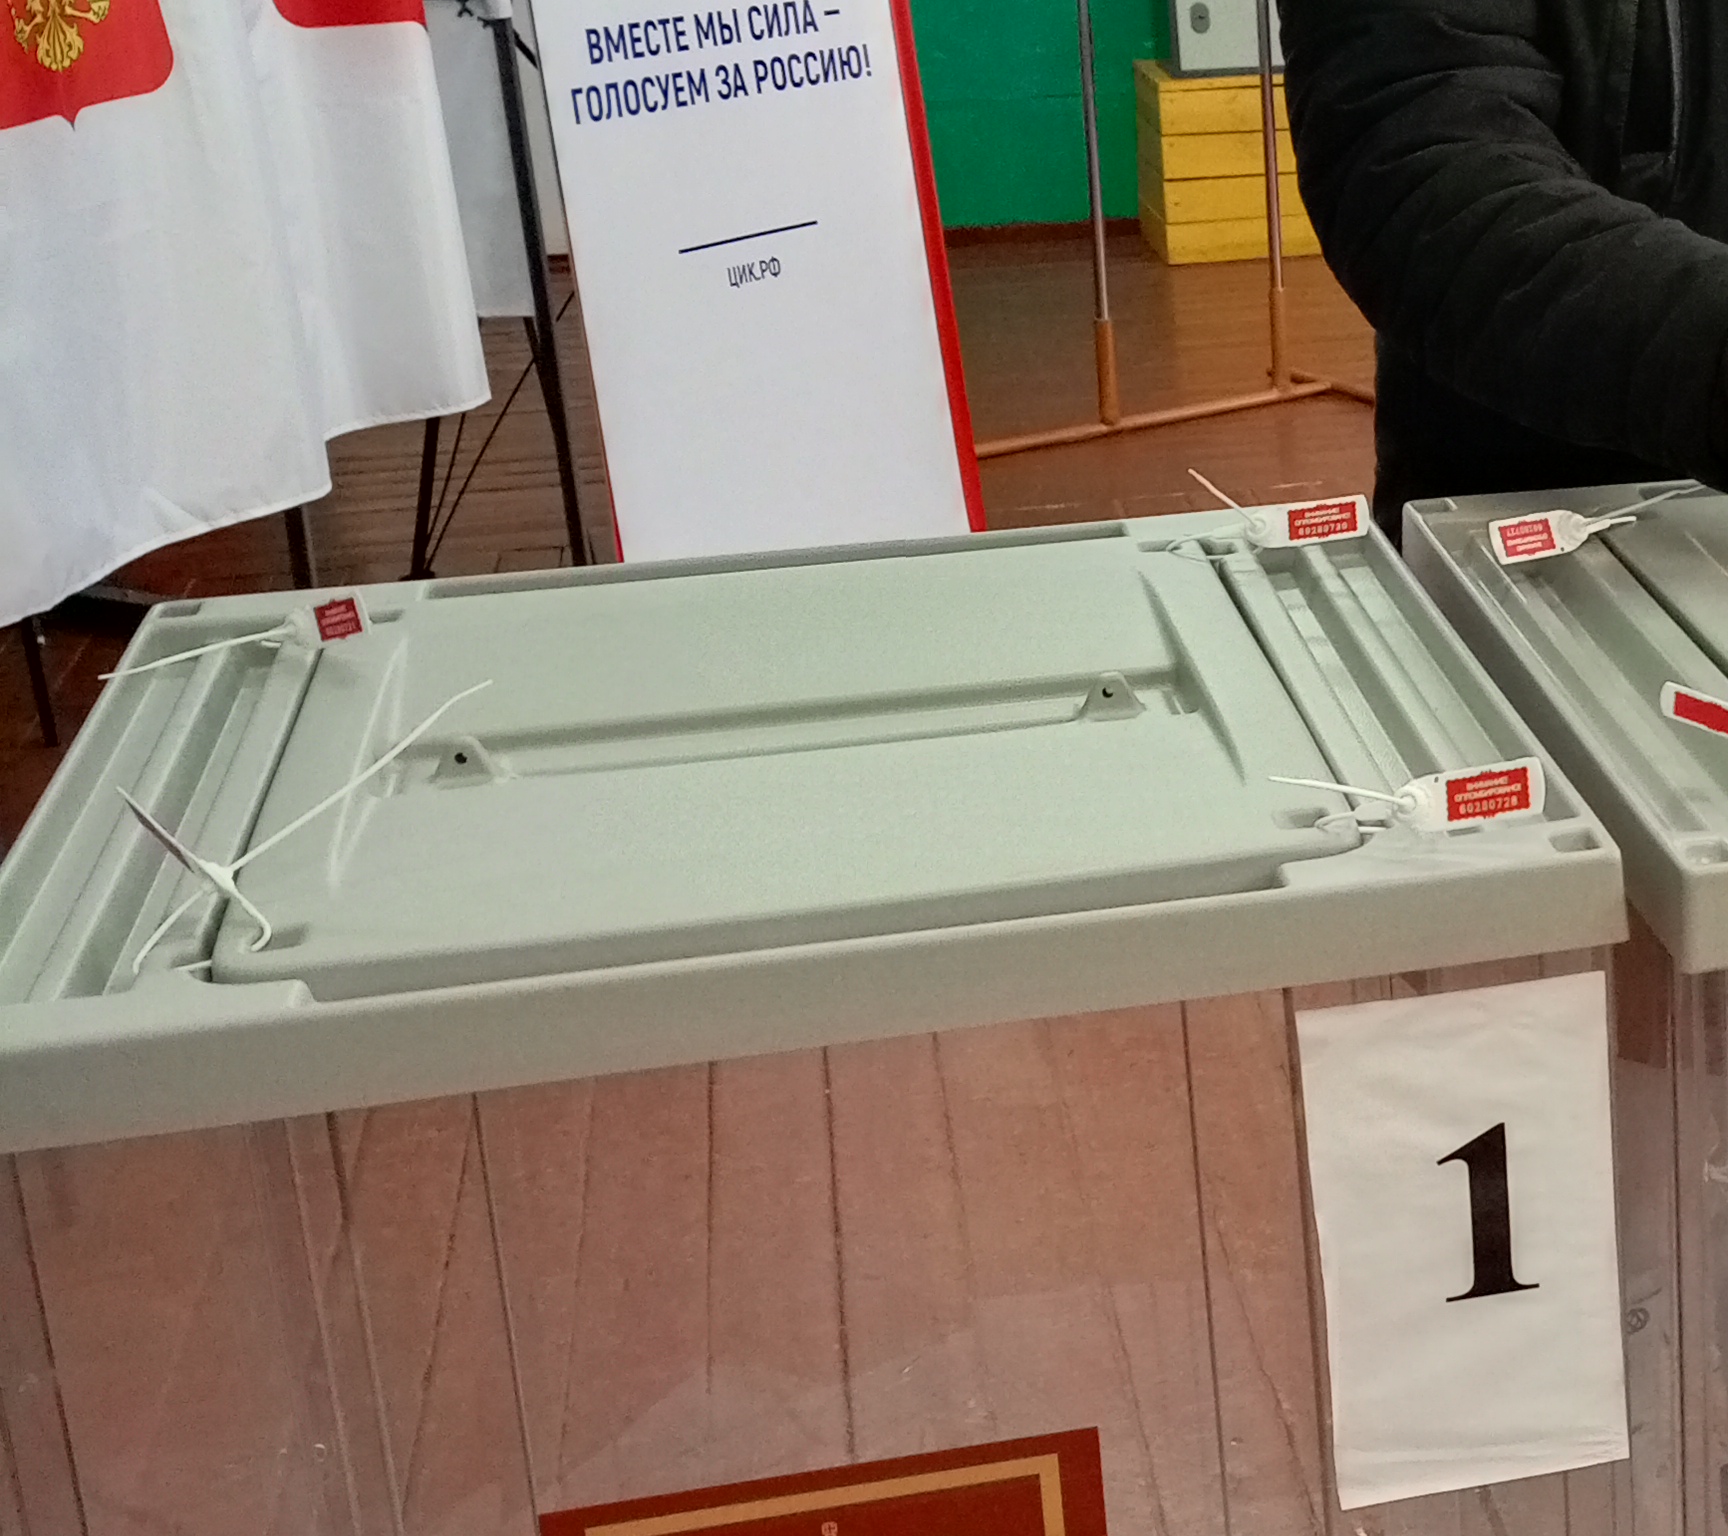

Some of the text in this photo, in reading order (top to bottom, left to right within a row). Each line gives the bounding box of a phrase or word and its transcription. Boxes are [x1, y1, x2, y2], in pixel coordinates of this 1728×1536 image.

[585, 15, 690, 66] ВМЕСТЕ
[694, 7, 741, 48] МЫ
[570, 43, 873, 125] ГОЛОСУЕМ ЗА РОССИЮ!
[728, 257, 781, 289] ЦИК.РФ
[1436, 1121, 1539, 1302] 1
